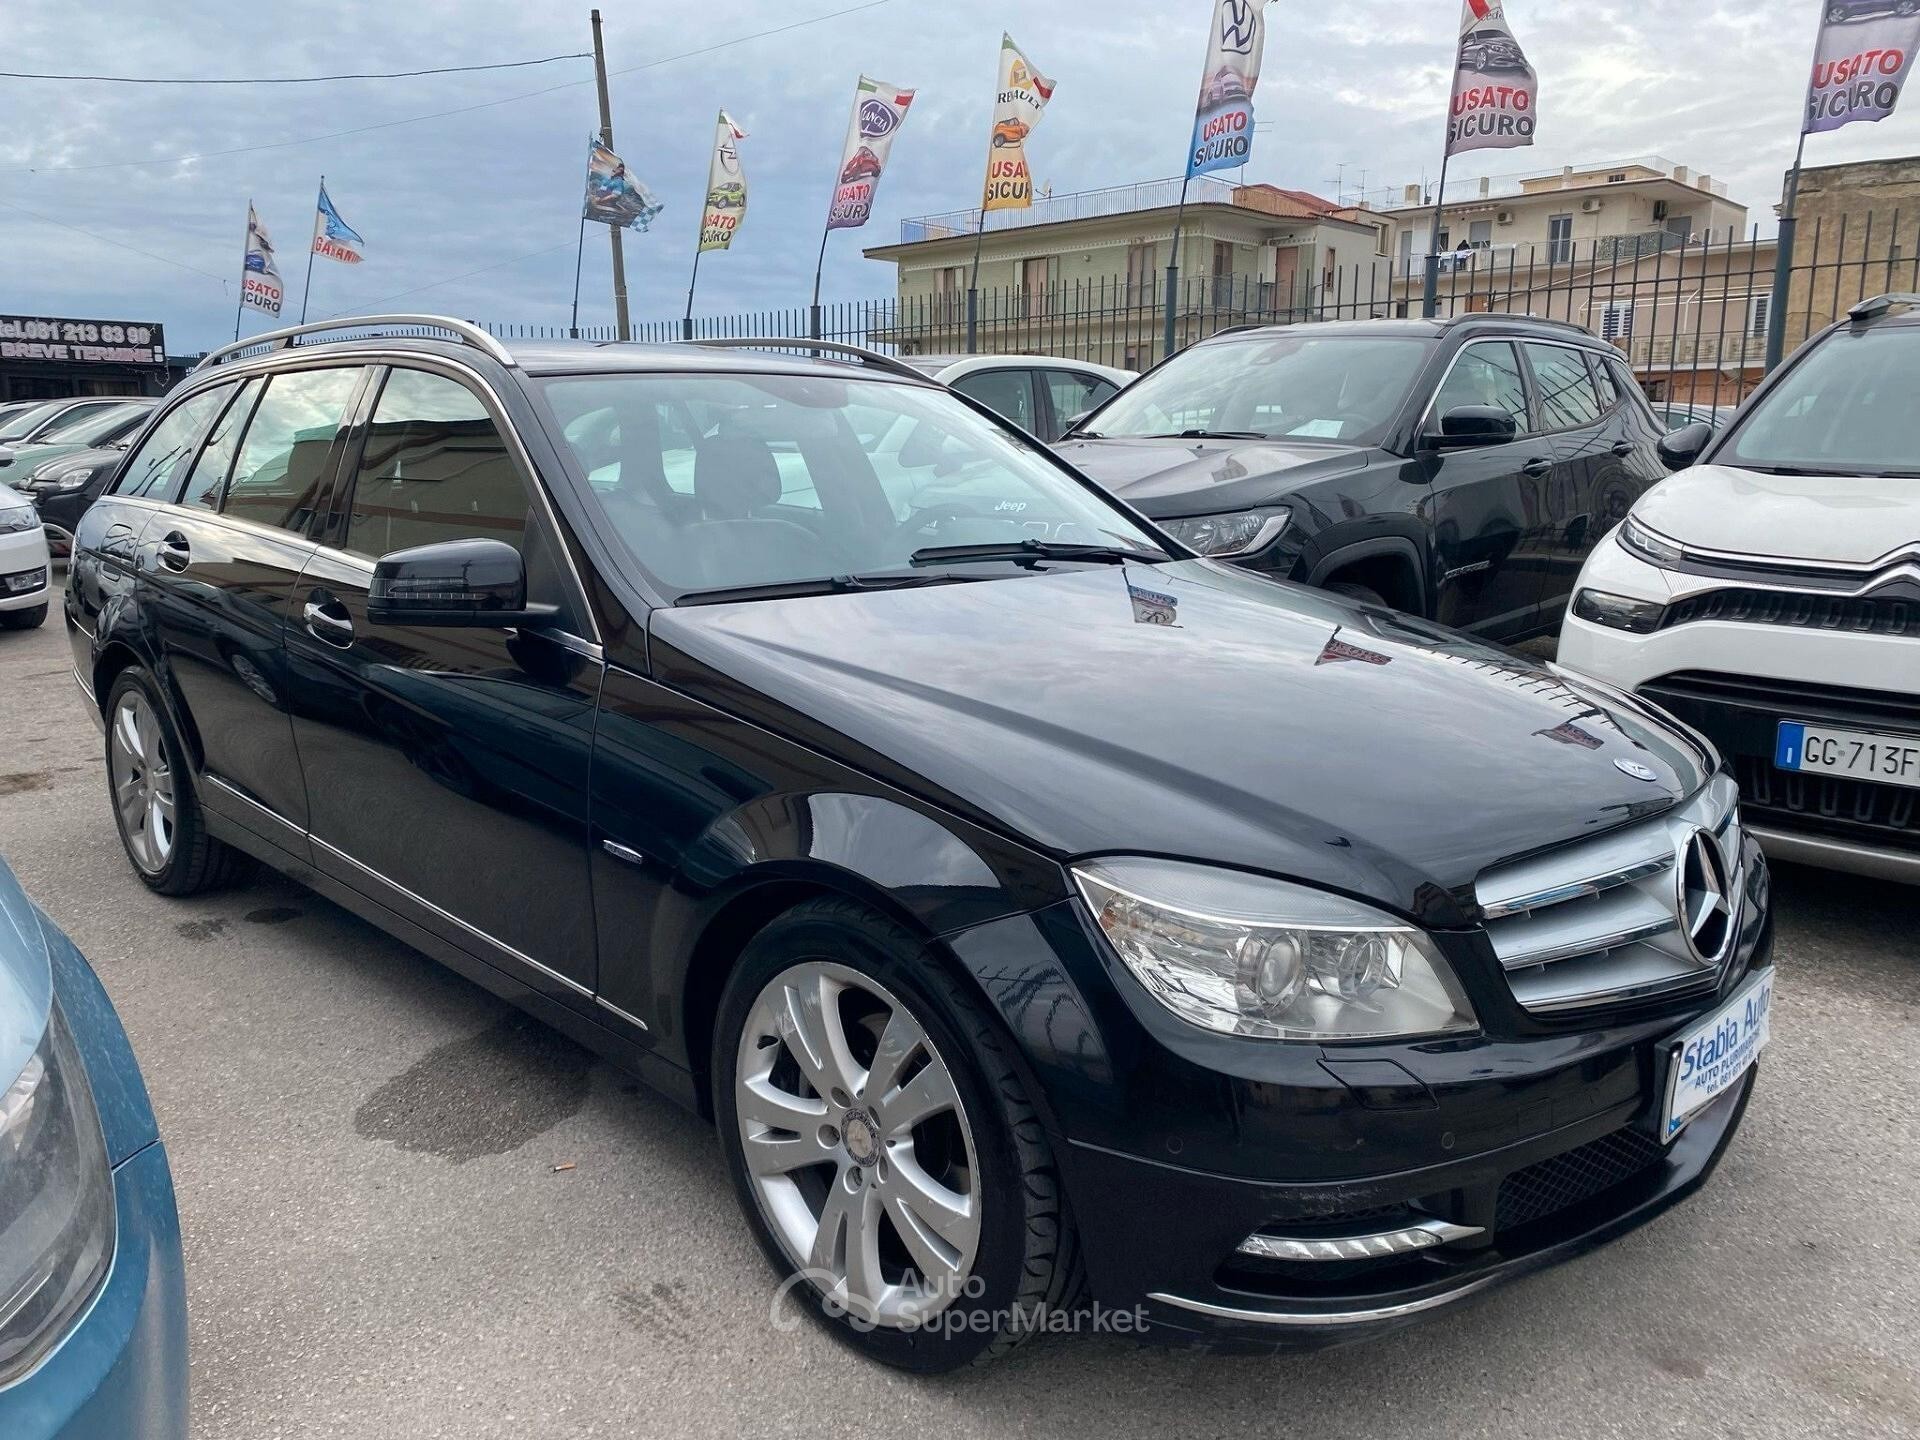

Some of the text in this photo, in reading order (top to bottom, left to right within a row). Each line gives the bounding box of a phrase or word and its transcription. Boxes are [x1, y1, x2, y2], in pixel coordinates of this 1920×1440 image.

[1814, 49, 1904, 89] USATO
[998, 89, 1041, 110] REAULT
[1452, 86, 1529, 116] USATO
[1203, 111, 1248, 142] USATO
[1449, 113, 1534, 145] SICURO
[1193, 135, 1249, 168] SICURO
[992, 161, 1027, 178] USA
[838, 184, 870, 203] USATO
[242, 292, 281, 312] ICURO
[0, 341, 69, 359] BREVE
[994, 500, 1027, 512] Jeep
[1847, 741, 1920, 778] 713F
[1680, 1017, 1738, 1081] Stabia
[1743, 985, 1770, 1037] Auto
